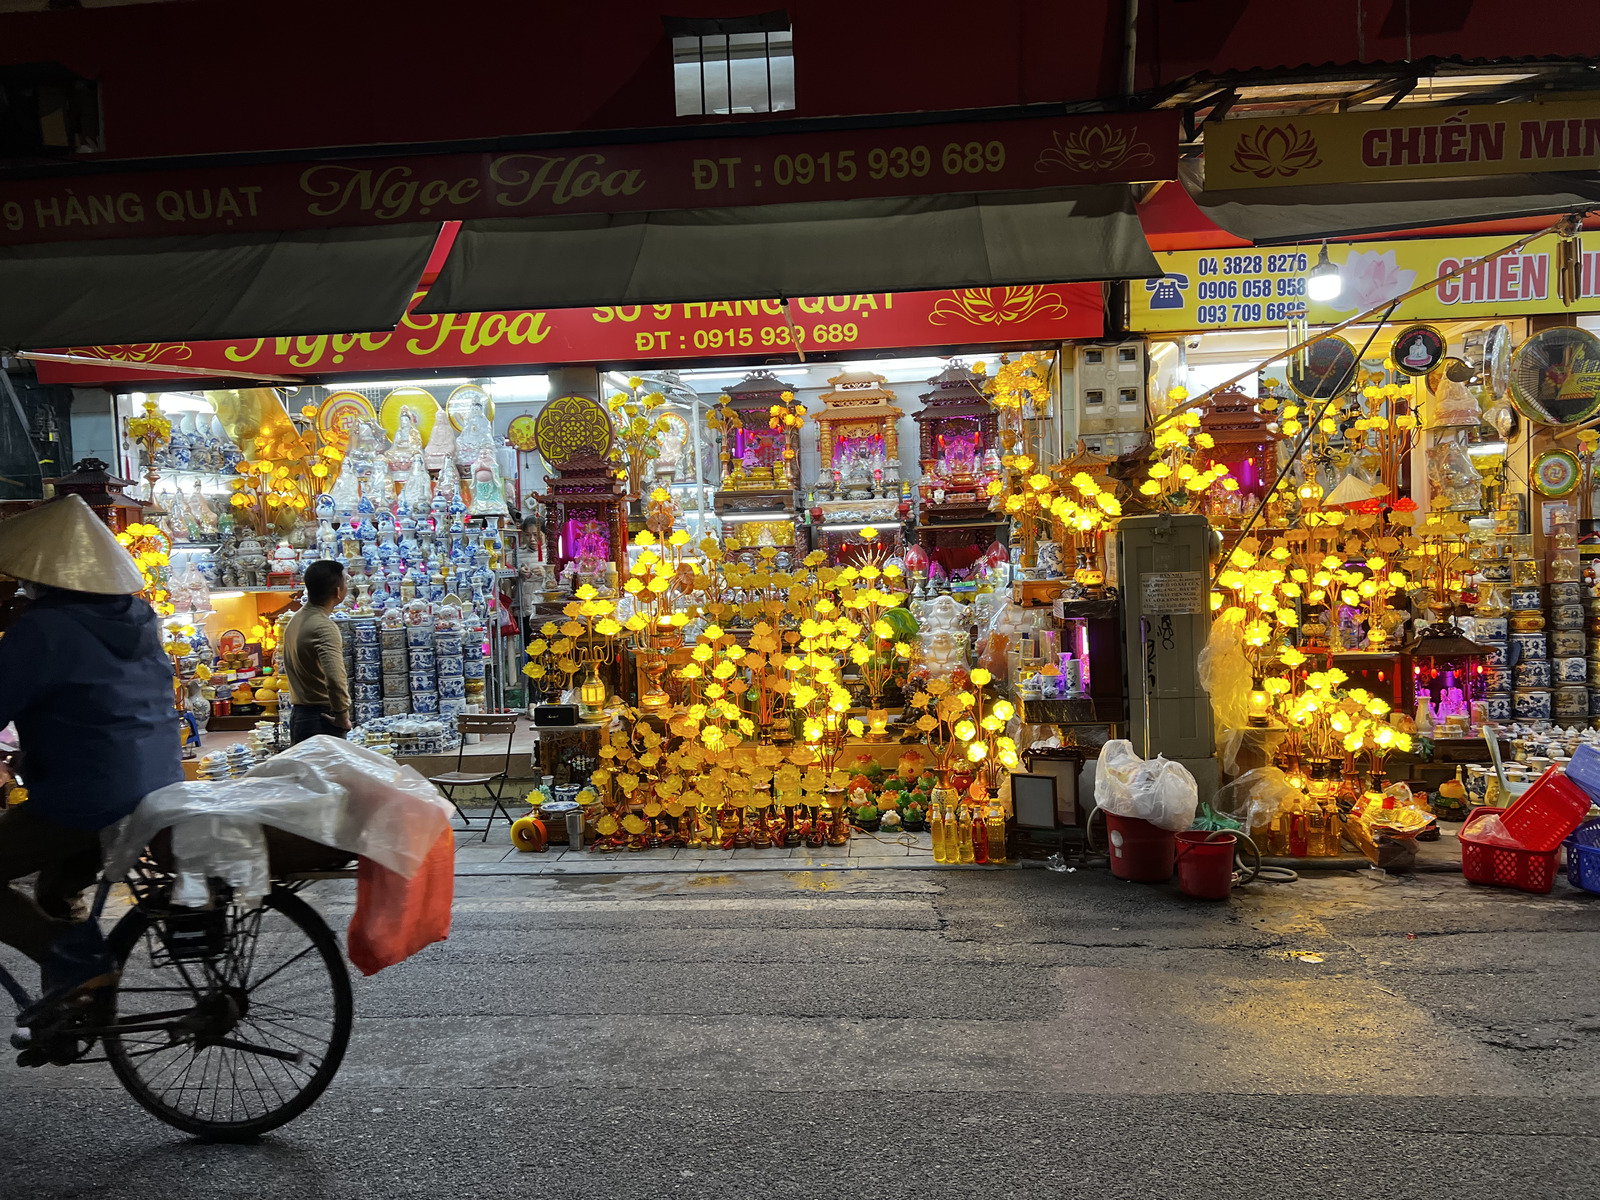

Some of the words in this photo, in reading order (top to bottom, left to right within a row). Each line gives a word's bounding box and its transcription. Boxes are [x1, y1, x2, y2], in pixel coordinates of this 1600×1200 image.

[1362, 109, 1506, 167] CHIẾN
[692, 157, 741, 190] ĐT
[773, 150, 857, 186] 0915
[868, 145, 931, 180] 939
[942, 140, 1006, 174] 689
[299, 164, 482, 219] Ngọc
[489, 153, 646, 207] Hoa
[2, 200, 25, 231] 9
[34, 188, 145, 228] HÀNG
[156, 186, 264, 226] QUẠT
[1198, 257, 1218, 276] 04
[1223, 256, 1262, 275] 3828
[1267, 253, 1307, 273] 8276
[1198, 280, 1237, 300] 0906
[1242, 279, 1272, 298] 058
[1277, 278, 1306, 297] 958
[1198, 304, 1227, 324] 093
[1231, 303, 1262, 322] 709
[635, 331, 671, 351] ĐT
[693, 328, 753, 349] 0915
[760, 324, 806, 346] 939
[813, 322, 858, 344] 689
